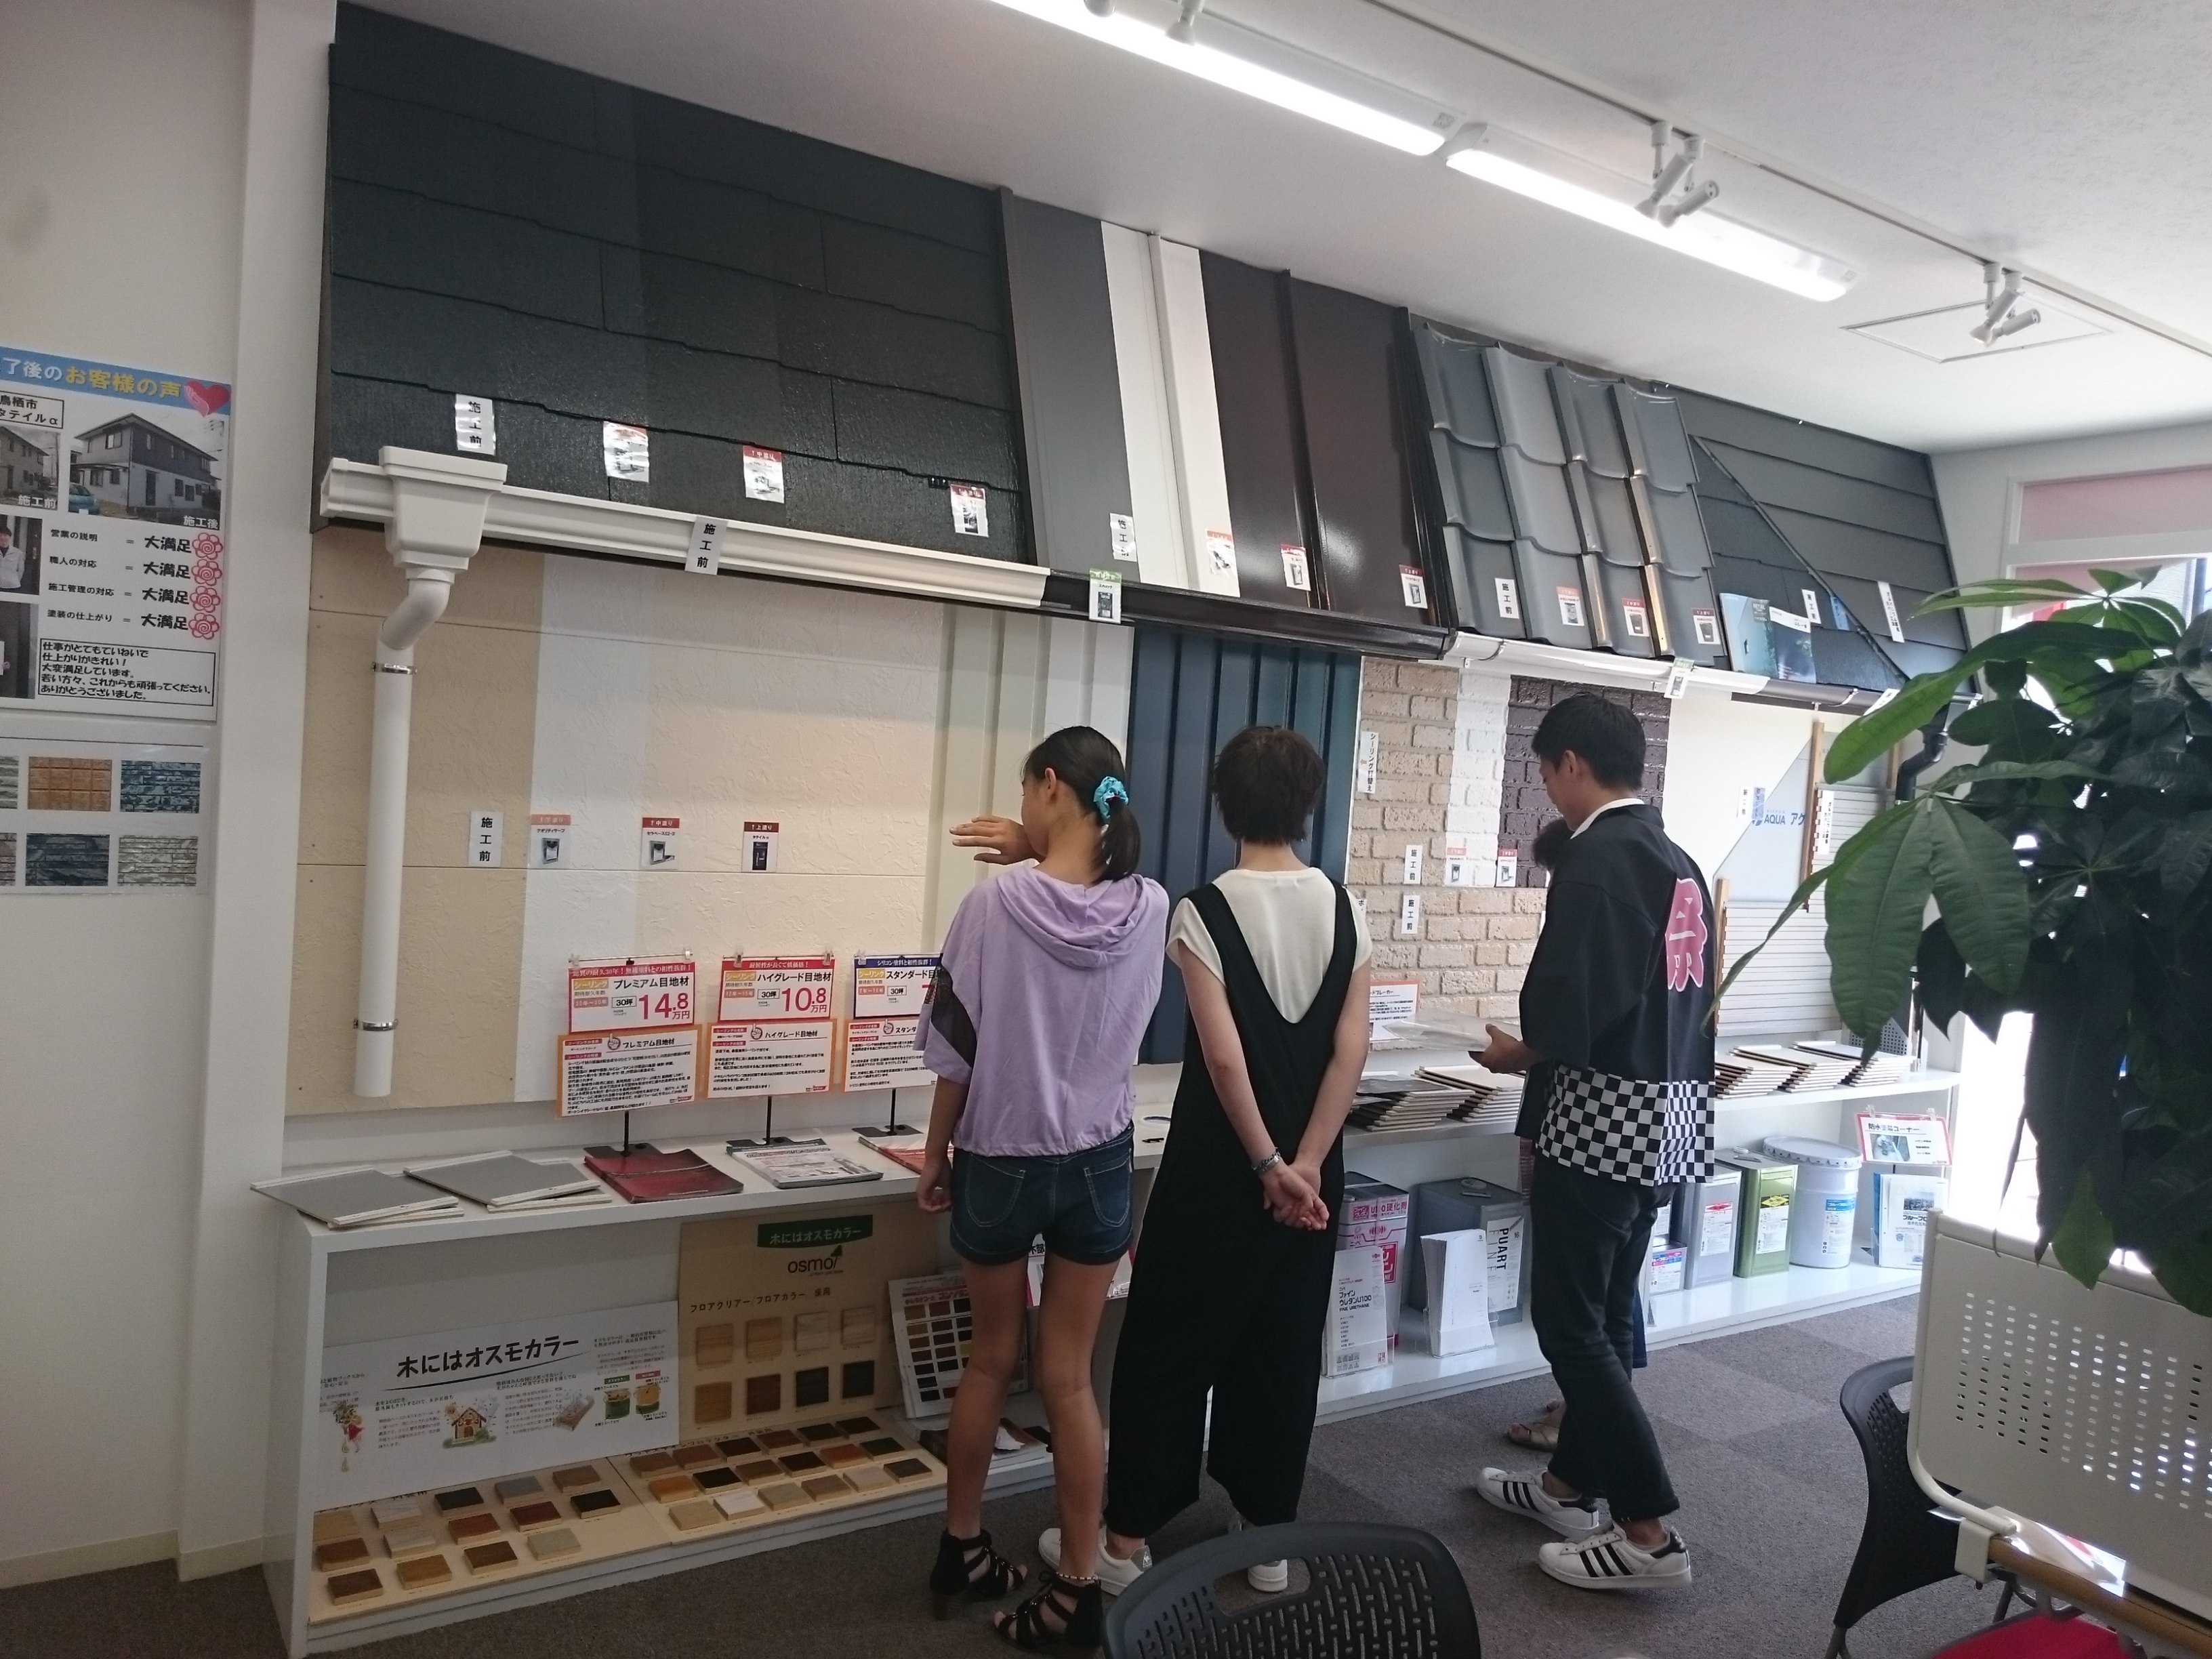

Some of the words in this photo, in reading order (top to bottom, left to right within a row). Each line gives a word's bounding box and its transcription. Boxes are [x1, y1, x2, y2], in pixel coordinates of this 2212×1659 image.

[0, 357, 181, 398] 了後のお客様の声
[0, 395, 37, 409] 鳥栖市
[18, 495, 56, 509] 施工前
[184, 515, 218, 529] 施工後
[50, 529, 98, 541] 営業の説明
[144, 535, 192, 553] 大満足
[697, 523, 716, 569] 施工前
[49, 556, 97, 568] 職人の対応
[143, 562, 191, 579] 大満足
[48, 583, 114, 596] 施工管理の対応
[142, 588, 189, 605] 大満足
[47, 610, 112, 622] 塗装の仕上がり
[141, 613, 188, 630] 大満足
[43, 642, 148, 657] 仕事がとてもていねいで
[1764, 815, 1786, 825] AQUA
[479, 817, 493, 861] 施工前
[1407, 899, 1415, 930] 施工前
[757, 972, 832, 982] ハイグレード目地材
[859, 970, 885, 978] シーリング
[575, 980, 608, 989] シーリング
[614, 976, 689, 989] プレミアム目地材
[639, 992, 689, 1020] 14.8
[672, 1010, 690, 1020] 万円
[781, 987, 827, 1012] 10.8
[811, 1004, 827, 1013] 万円
[765, 1030, 818, 1038] ハイグレード目地材
[623, 1038, 675, 1048] プレミアム目地材
[770, 1227, 861, 1245] 木にはオスモカラー
[1496, 1228, 1509, 1269] PUART
[787, 1257, 834, 1273] osmo
[815, 1288, 830, 1297] 床用
[1339, 1290, 1355, 1298] ファイン
[691, 1292, 806, 1313] フロアクリアー/フロアカラー
[1339, 1295, 1372, 1307] ウレタンU100
[396, 1335, 579, 1378] 木にはオスモカラー
